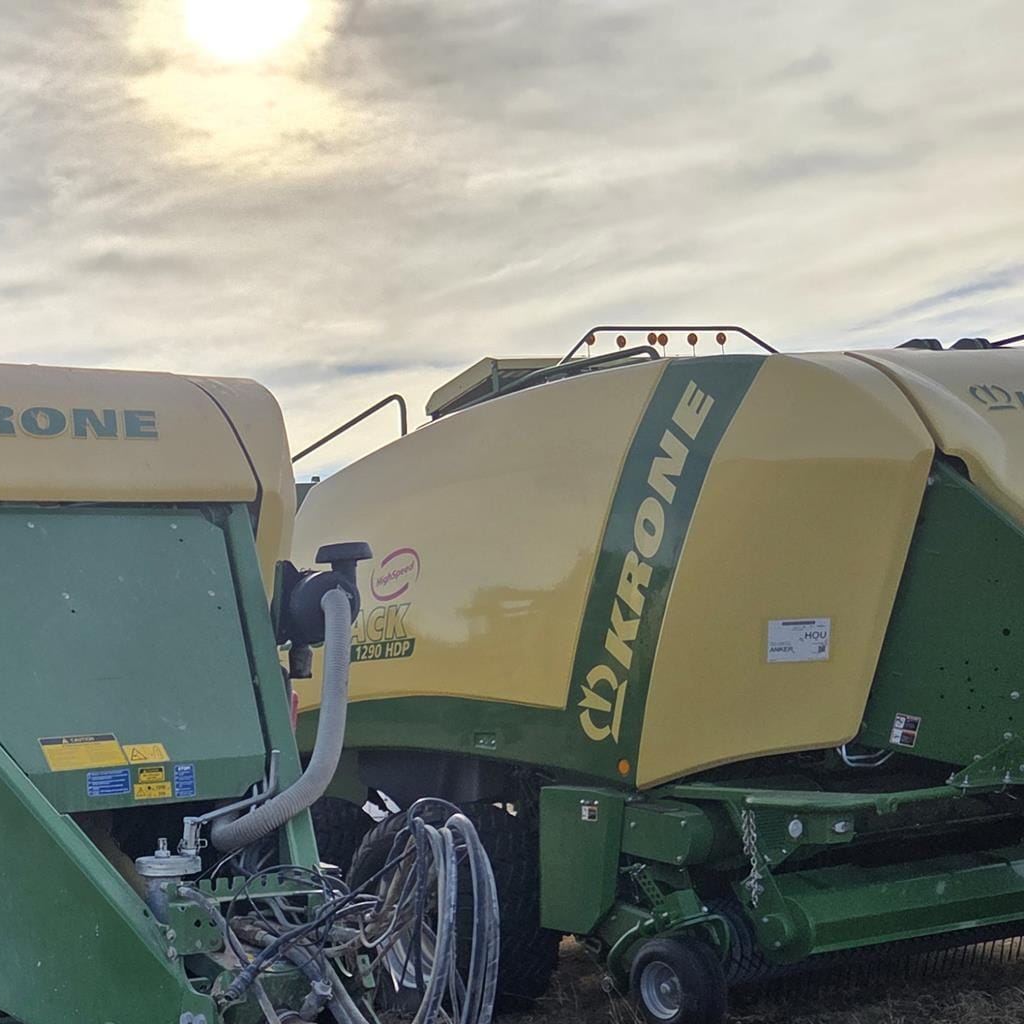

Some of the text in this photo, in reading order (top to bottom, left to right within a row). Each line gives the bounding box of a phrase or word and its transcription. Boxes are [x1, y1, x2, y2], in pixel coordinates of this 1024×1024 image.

[604, 379, 715, 670] KRONE
[350, 602, 412, 644] ACK
[356, 640, 410, 661] 1290 HDP
